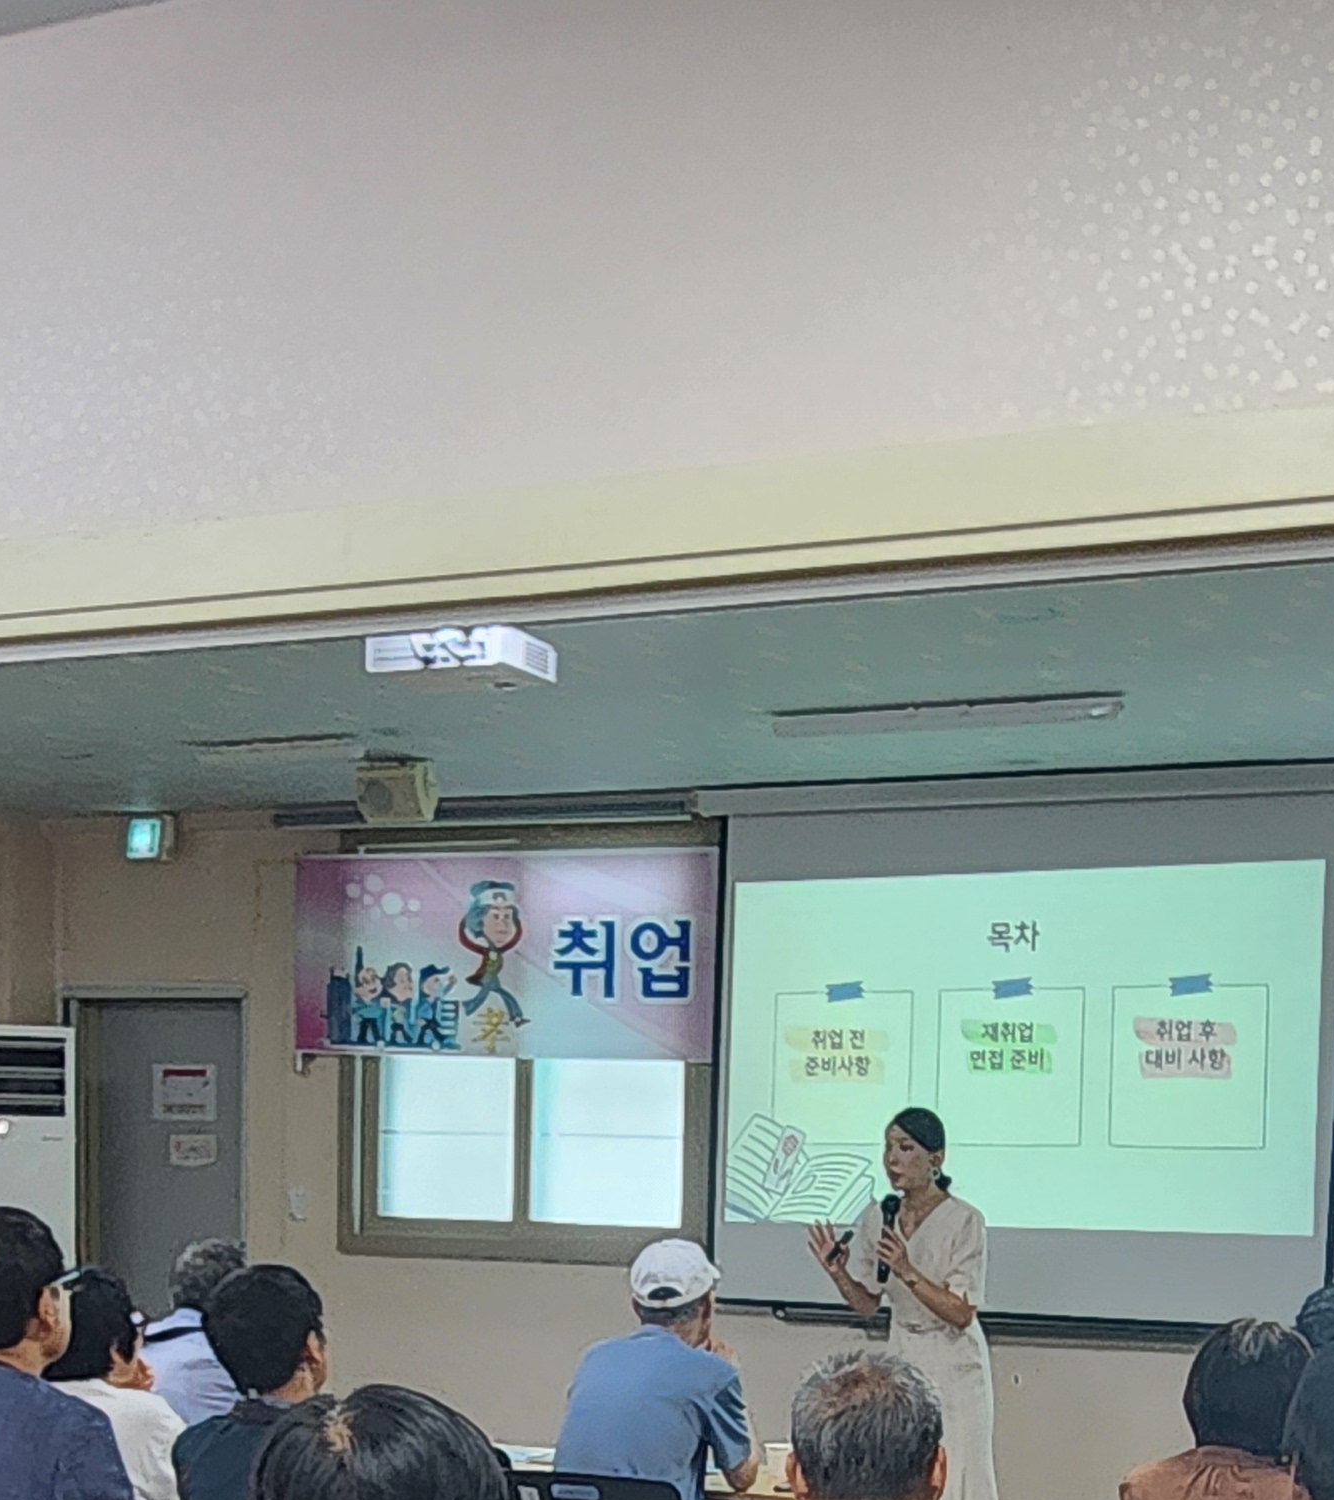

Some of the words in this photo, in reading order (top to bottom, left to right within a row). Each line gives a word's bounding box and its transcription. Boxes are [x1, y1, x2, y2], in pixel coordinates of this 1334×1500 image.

[987, 919, 1040, 952] 목차
[553, 918, 691, 998] 취업
[811, 1028, 844, 1051] 취업
[849, 1028, 866, 1050] 전
[981, 1021, 1034, 1043] 재취업
[1156, 1018, 1193, 1042] 취업
[1198, 1018, 1217, 1042] 후
[970, 1048, 1004, 1070] 면접
[1010, 1047, 1045, 1071] 준비
[1145, 1047, 1182, 1071] 대비
[1188, 1047, 1226, 1071] 사항
